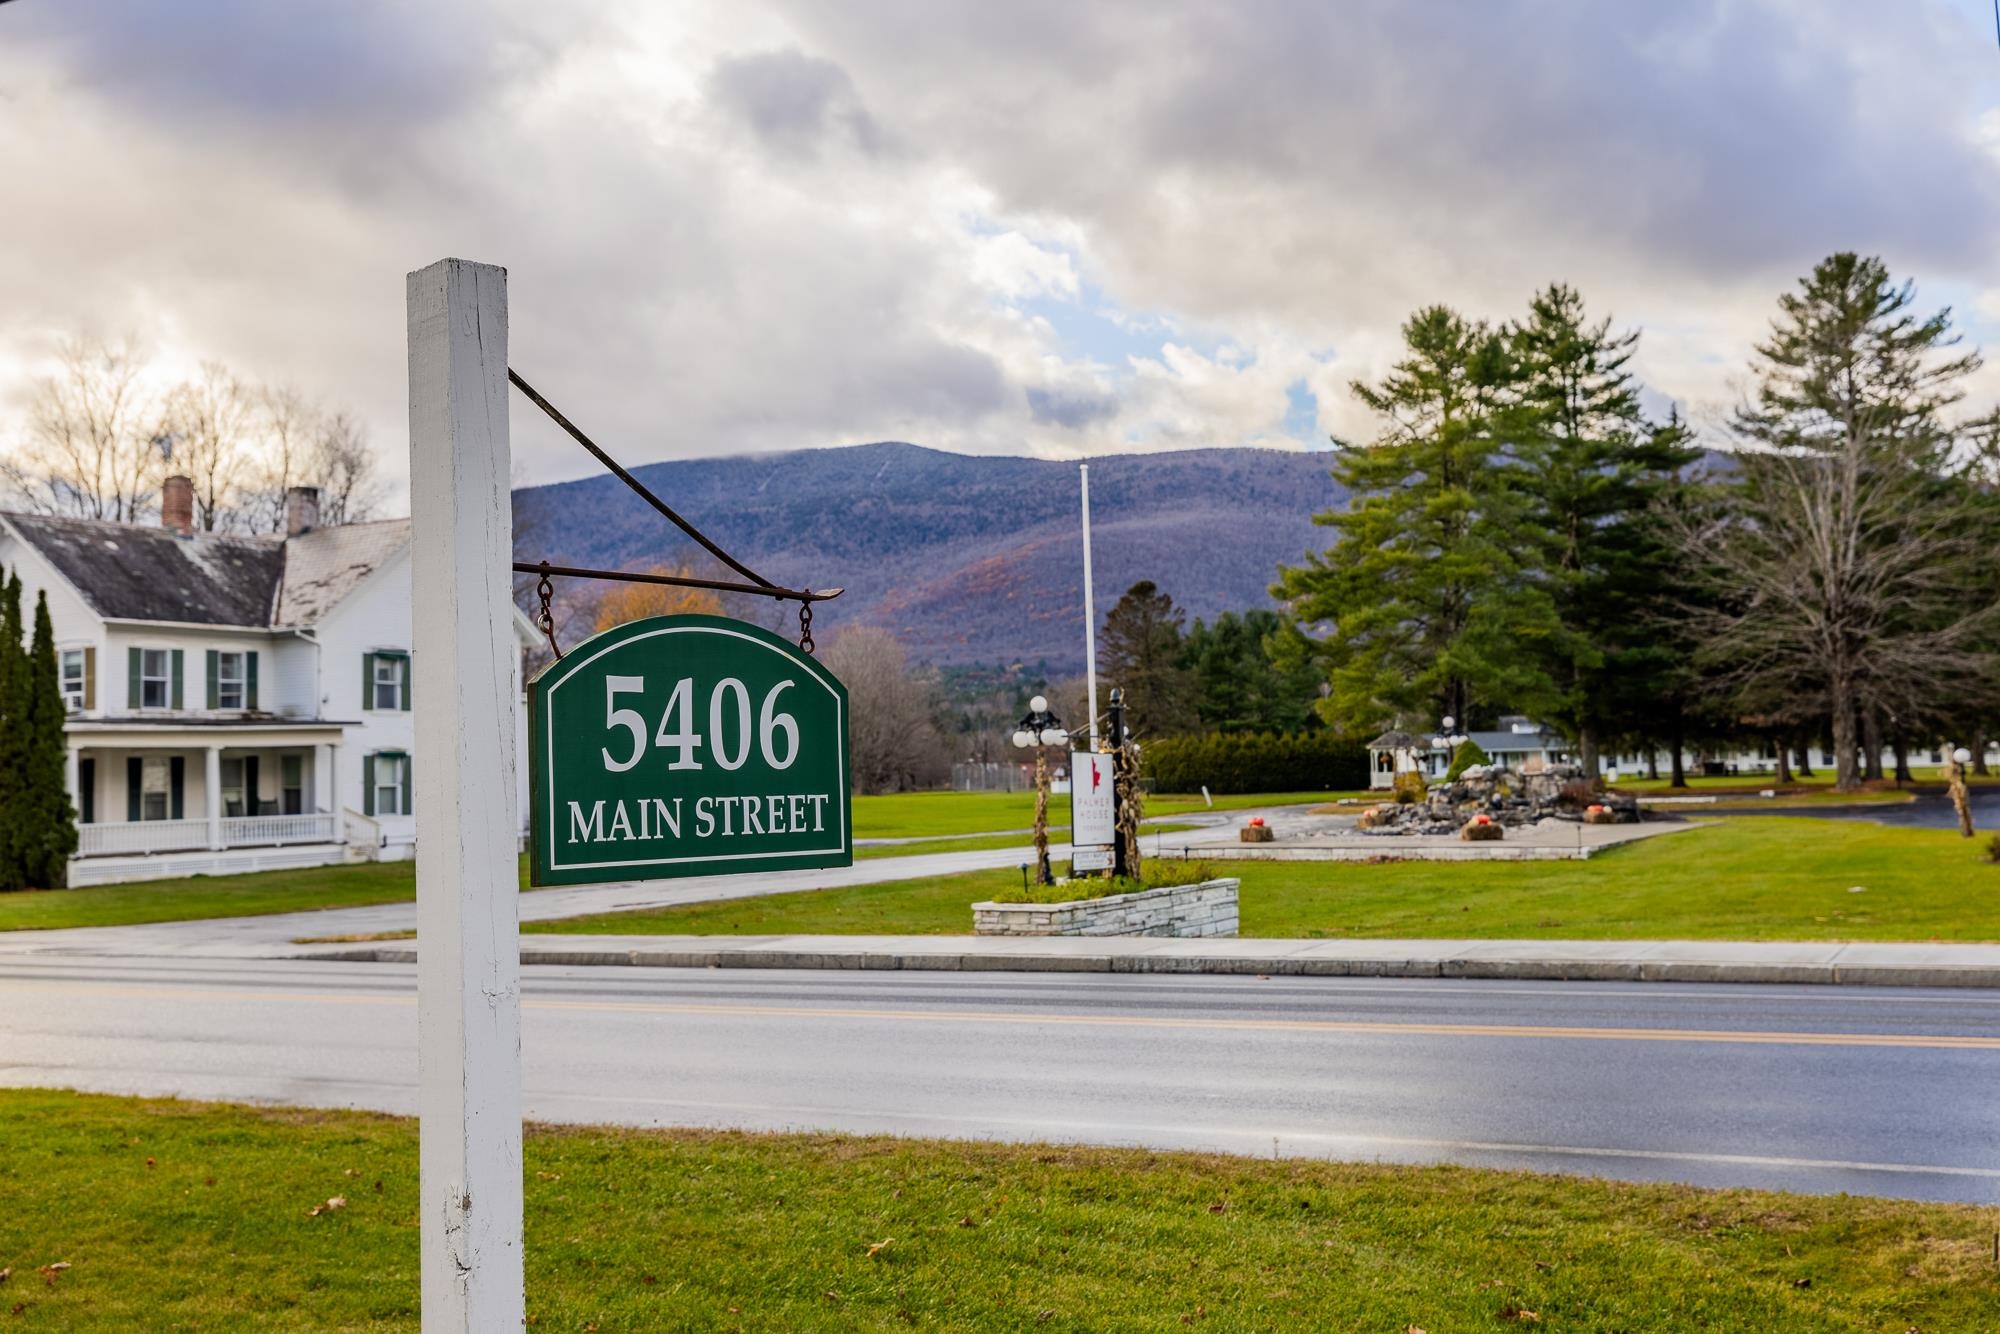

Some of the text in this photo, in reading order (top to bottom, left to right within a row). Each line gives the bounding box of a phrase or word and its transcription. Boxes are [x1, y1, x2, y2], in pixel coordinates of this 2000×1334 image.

[602, 675, 799, 772] 5406
[568, 794, 829, 843] MAIN STREET
